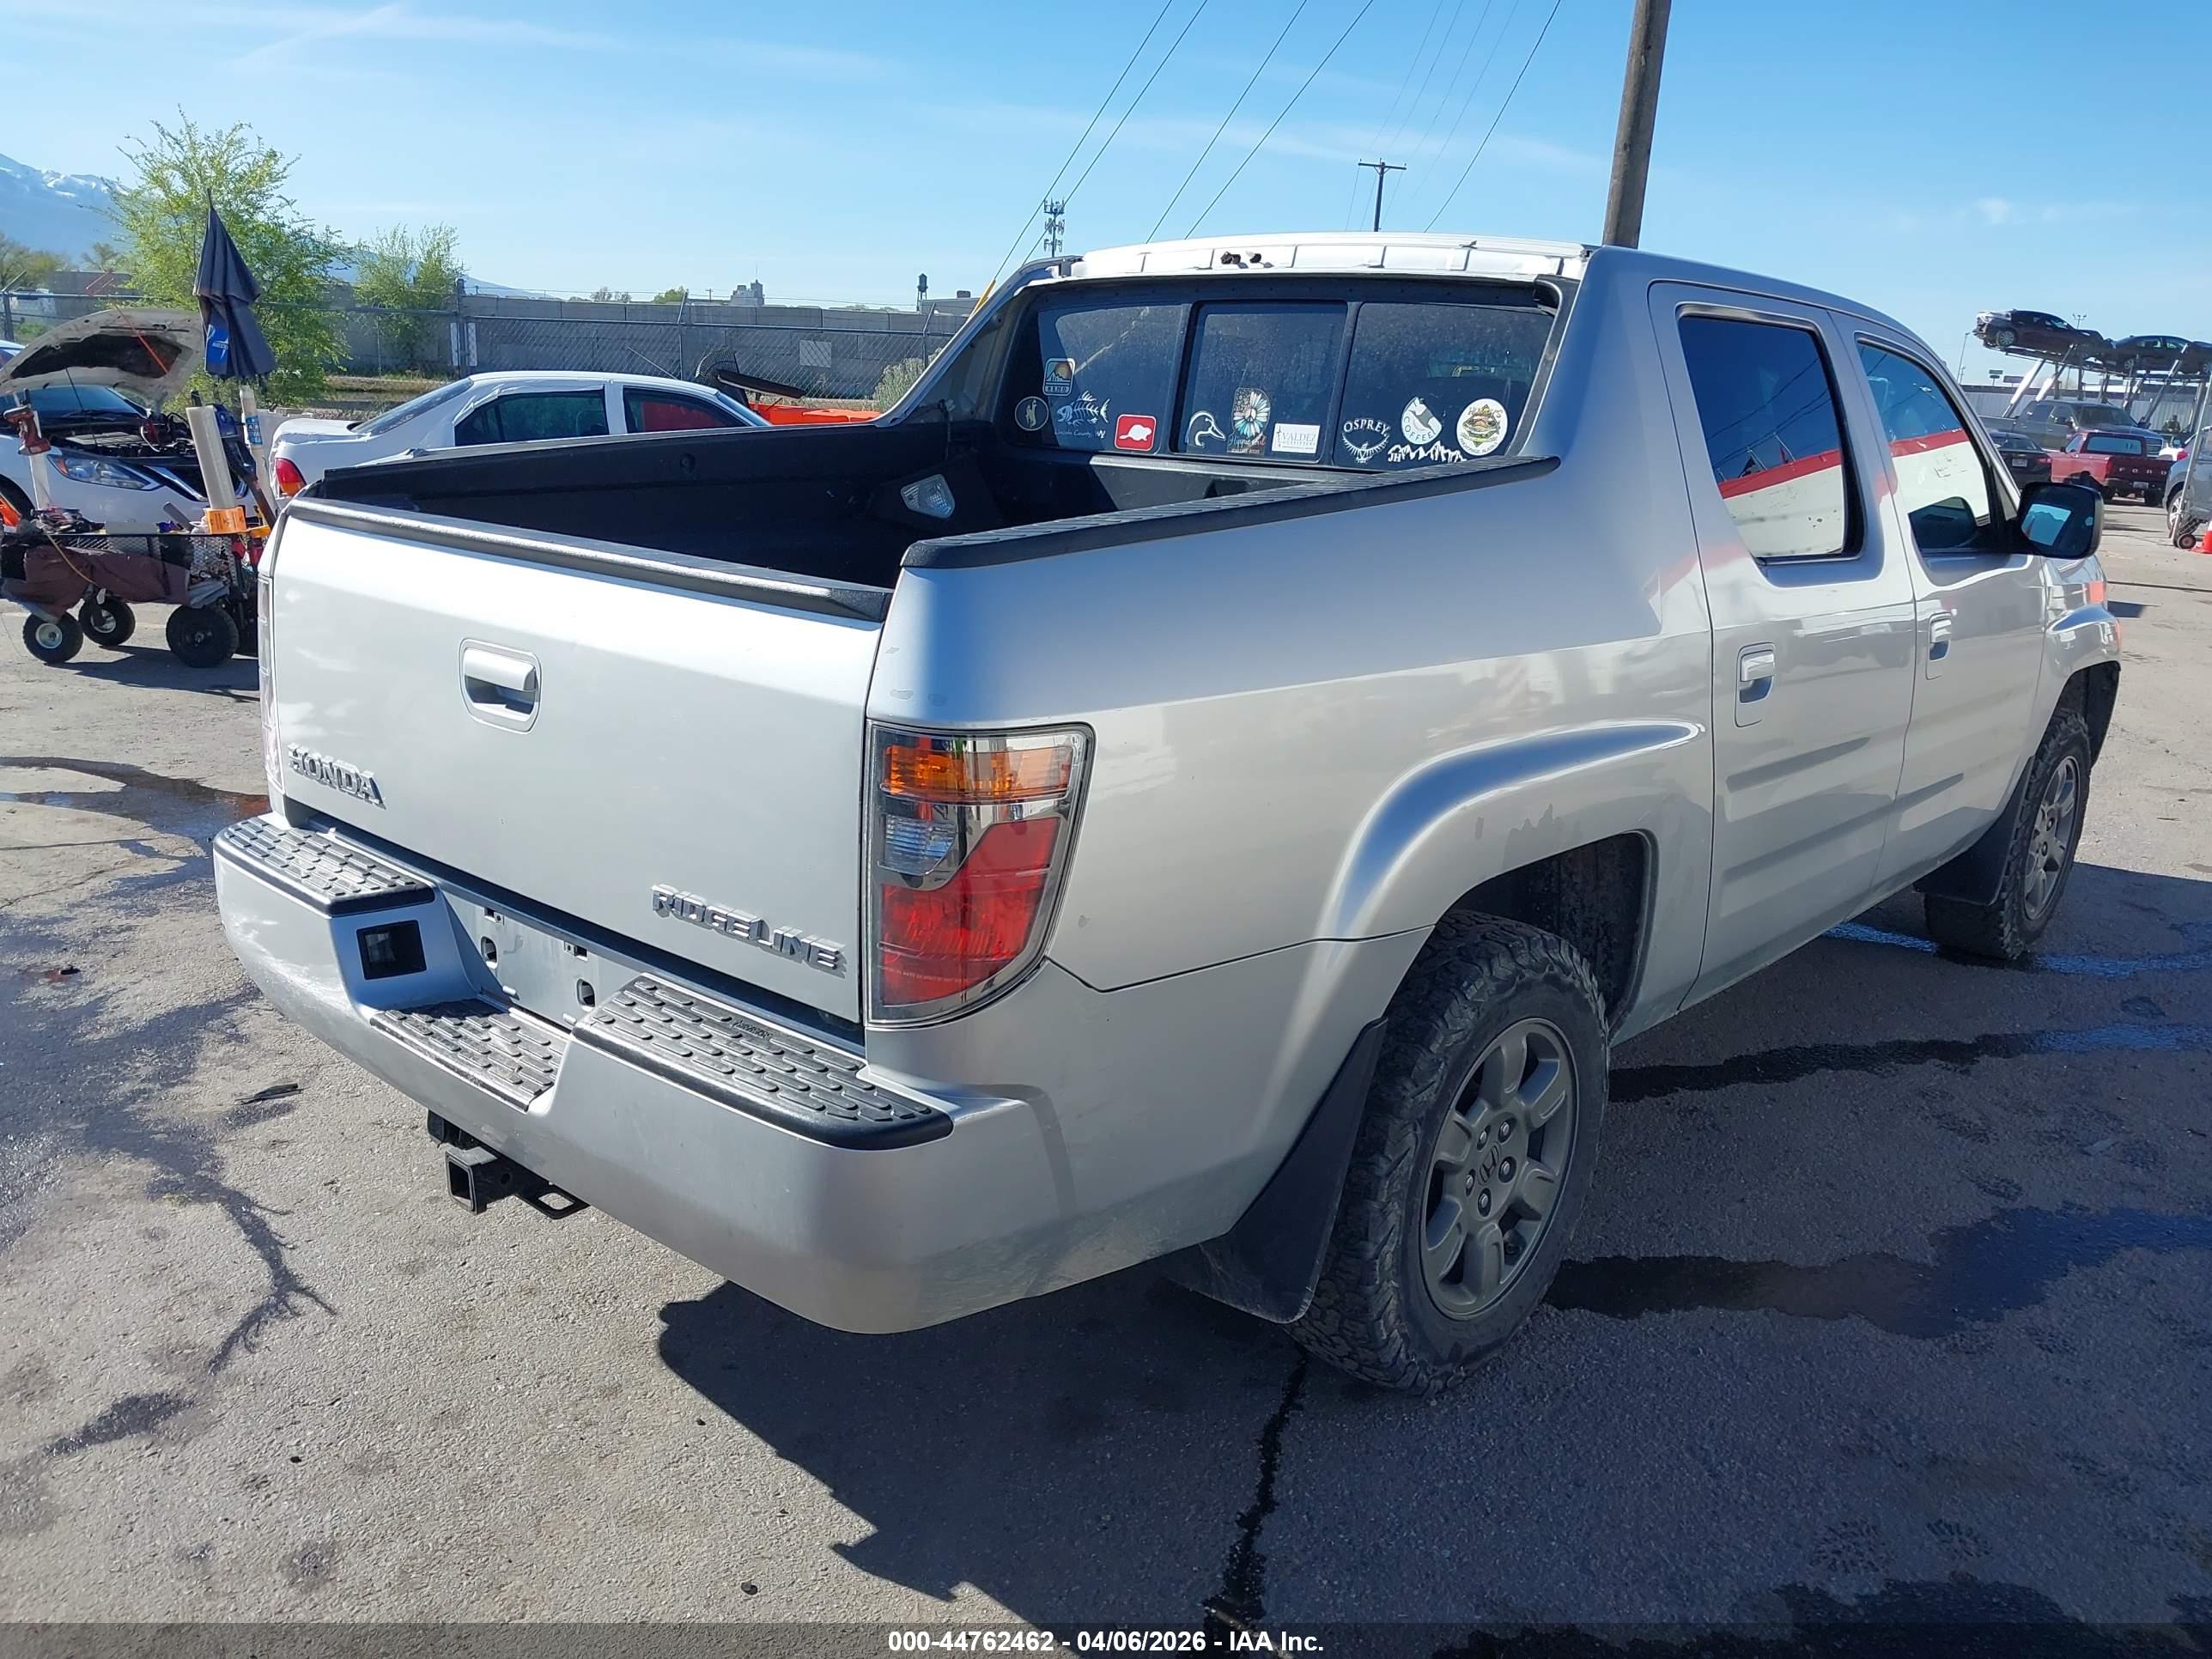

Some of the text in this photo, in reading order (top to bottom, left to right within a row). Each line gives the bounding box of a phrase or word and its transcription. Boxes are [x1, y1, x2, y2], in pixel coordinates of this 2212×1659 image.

[1282, 432, 1316, 442] VALDEZ
[1343, 419, 1390, 437] OSPREY
[1403, 416, 1434, 441] COFFEE
[288, 743, 386, 808] HONDA
[651, 884, 846, 975] RIDGELINE
